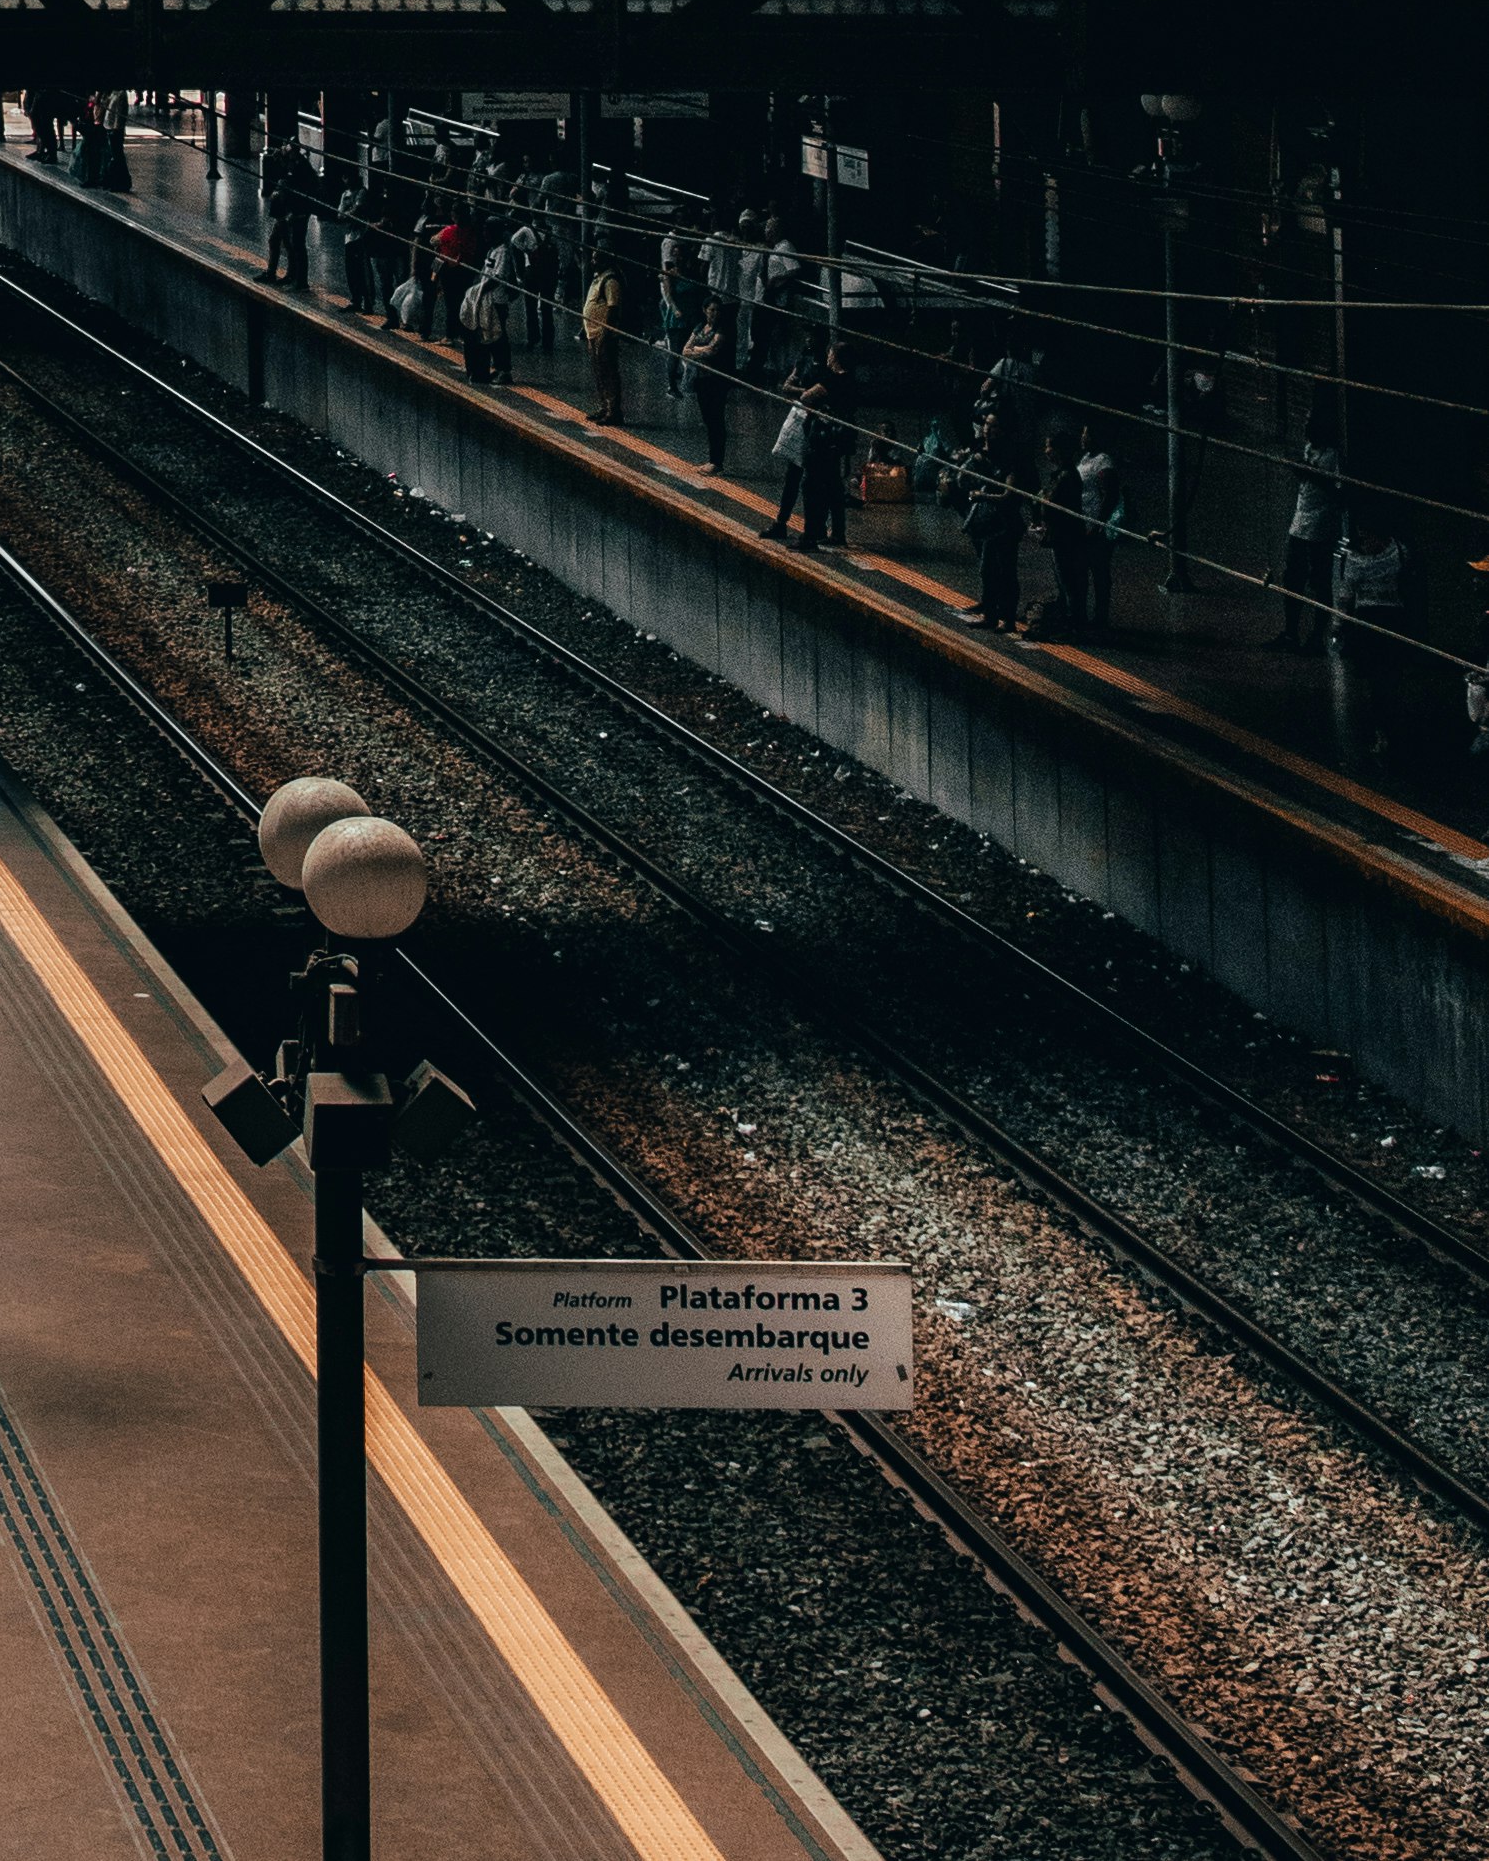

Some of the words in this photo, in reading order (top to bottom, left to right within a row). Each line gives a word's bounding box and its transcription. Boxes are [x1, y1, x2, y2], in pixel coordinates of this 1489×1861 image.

[553, 1291, 632, 1308] Platform
[660, 1283, 840, 1310] Plataforma
[851, 1288, 869, 1311] 3
[495, 1321, 639, 1346] Somente
[649, 1322, 870, 1355] desembarque
[726, 1363, 813, 1382] Arrivals
[820, 1364, 870, 1387] only
